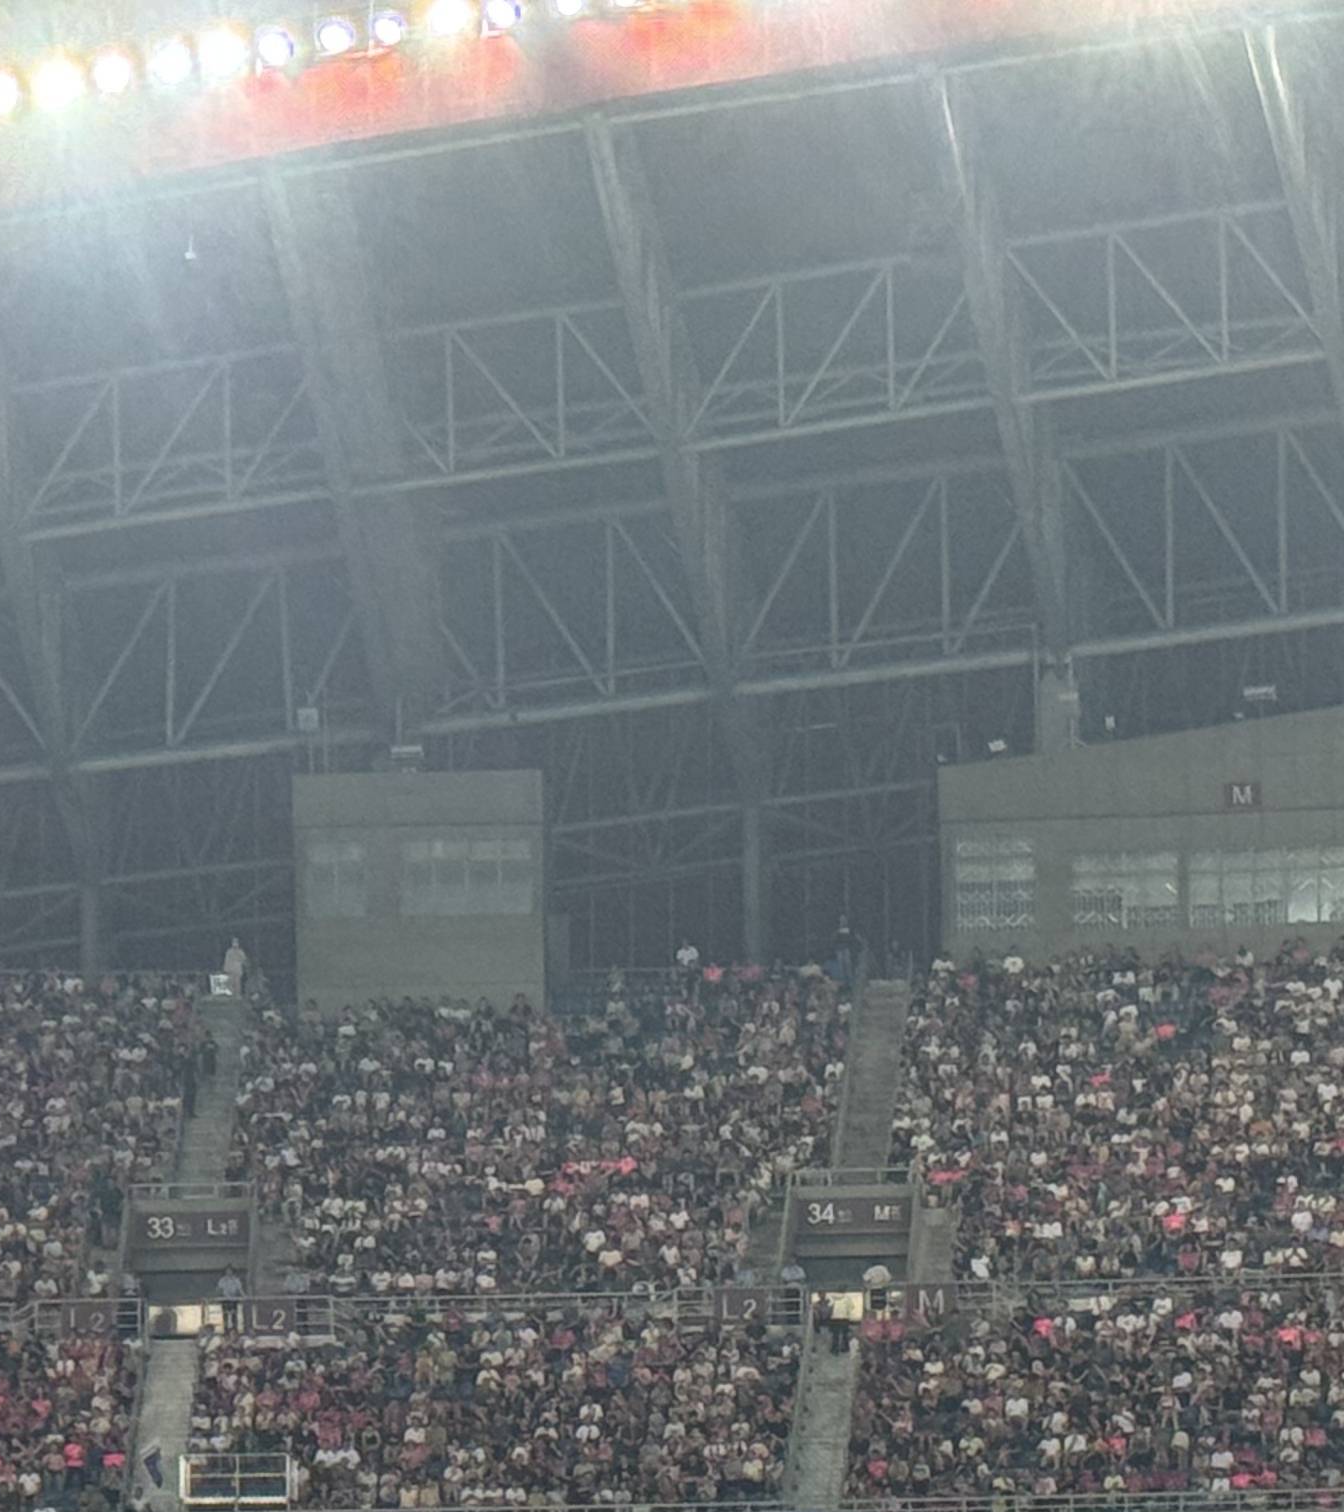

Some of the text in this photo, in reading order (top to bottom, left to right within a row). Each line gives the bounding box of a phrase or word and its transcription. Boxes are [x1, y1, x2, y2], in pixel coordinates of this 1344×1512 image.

[1231, 784, 1253, 805] M
[807, 1203, 834, 1225] 34
[146, 1217, 175, 1239] 33
[722, 1294, 757, 1320] L2
[918, 1289, 945, 1315] M
[250, 1304, 284, 1330] L2
